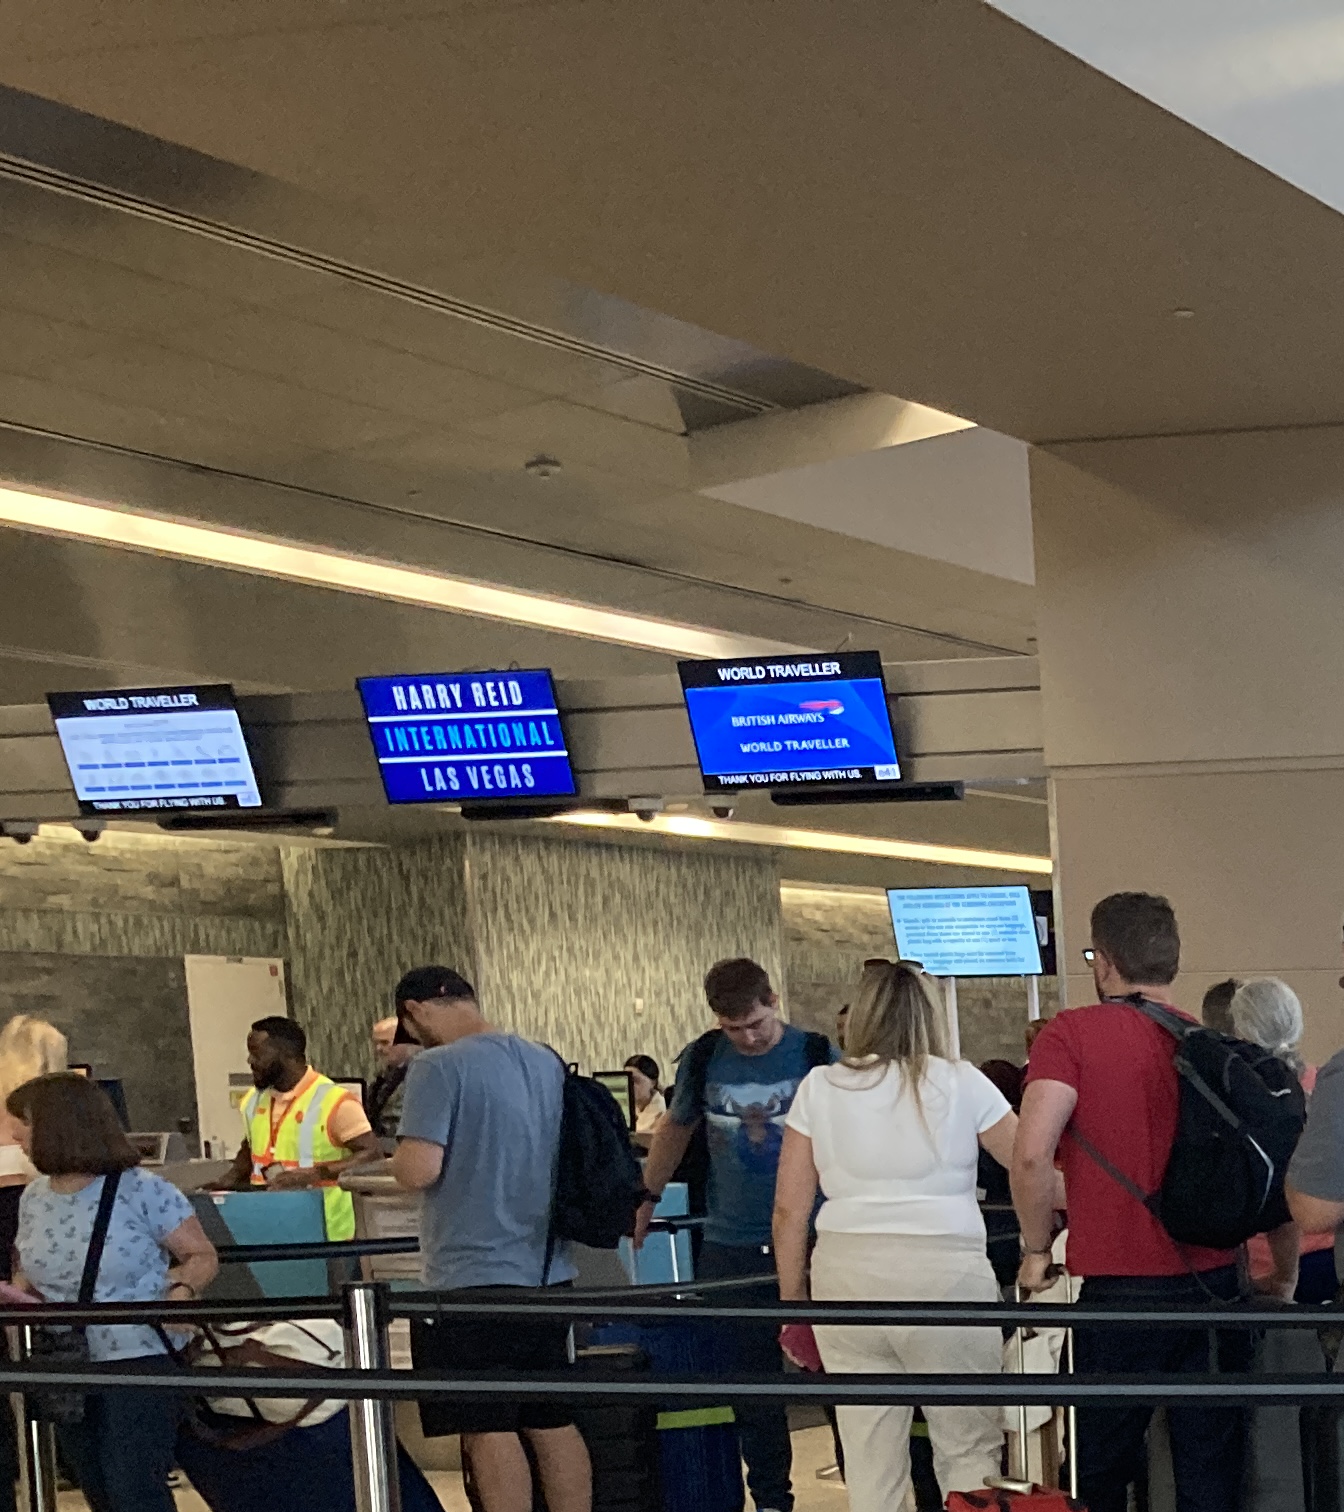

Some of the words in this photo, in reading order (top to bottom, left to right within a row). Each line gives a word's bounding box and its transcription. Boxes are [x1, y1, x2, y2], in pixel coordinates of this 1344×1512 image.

[717, 665, 766, 681] WORLD
[768, 661, 842, 679] TRAVELLER
[83, 697, 129, 711] WORLD
[129, 693, 200, 709] TRAVELLER
[392, 683, 463, 711] HARRY
[470, 680, 523, 708] REID
[731, 714, 776, 727] BRITISH
[777, 711, 825, 725] AIRWAYS
[384, 721, 555, 752] INTERNATIONAL
[740, 740, 783, 754] WORLD
[783, 737, 851, 752] TRAVELLER
[420, 767, 460, 792] LAS
[465, 763, 536, 790] VEGAS
[749, 773, 769, 783] YOU
[769, 772, 789, 782] FOR
[821, 769, 847, 780] WITH
